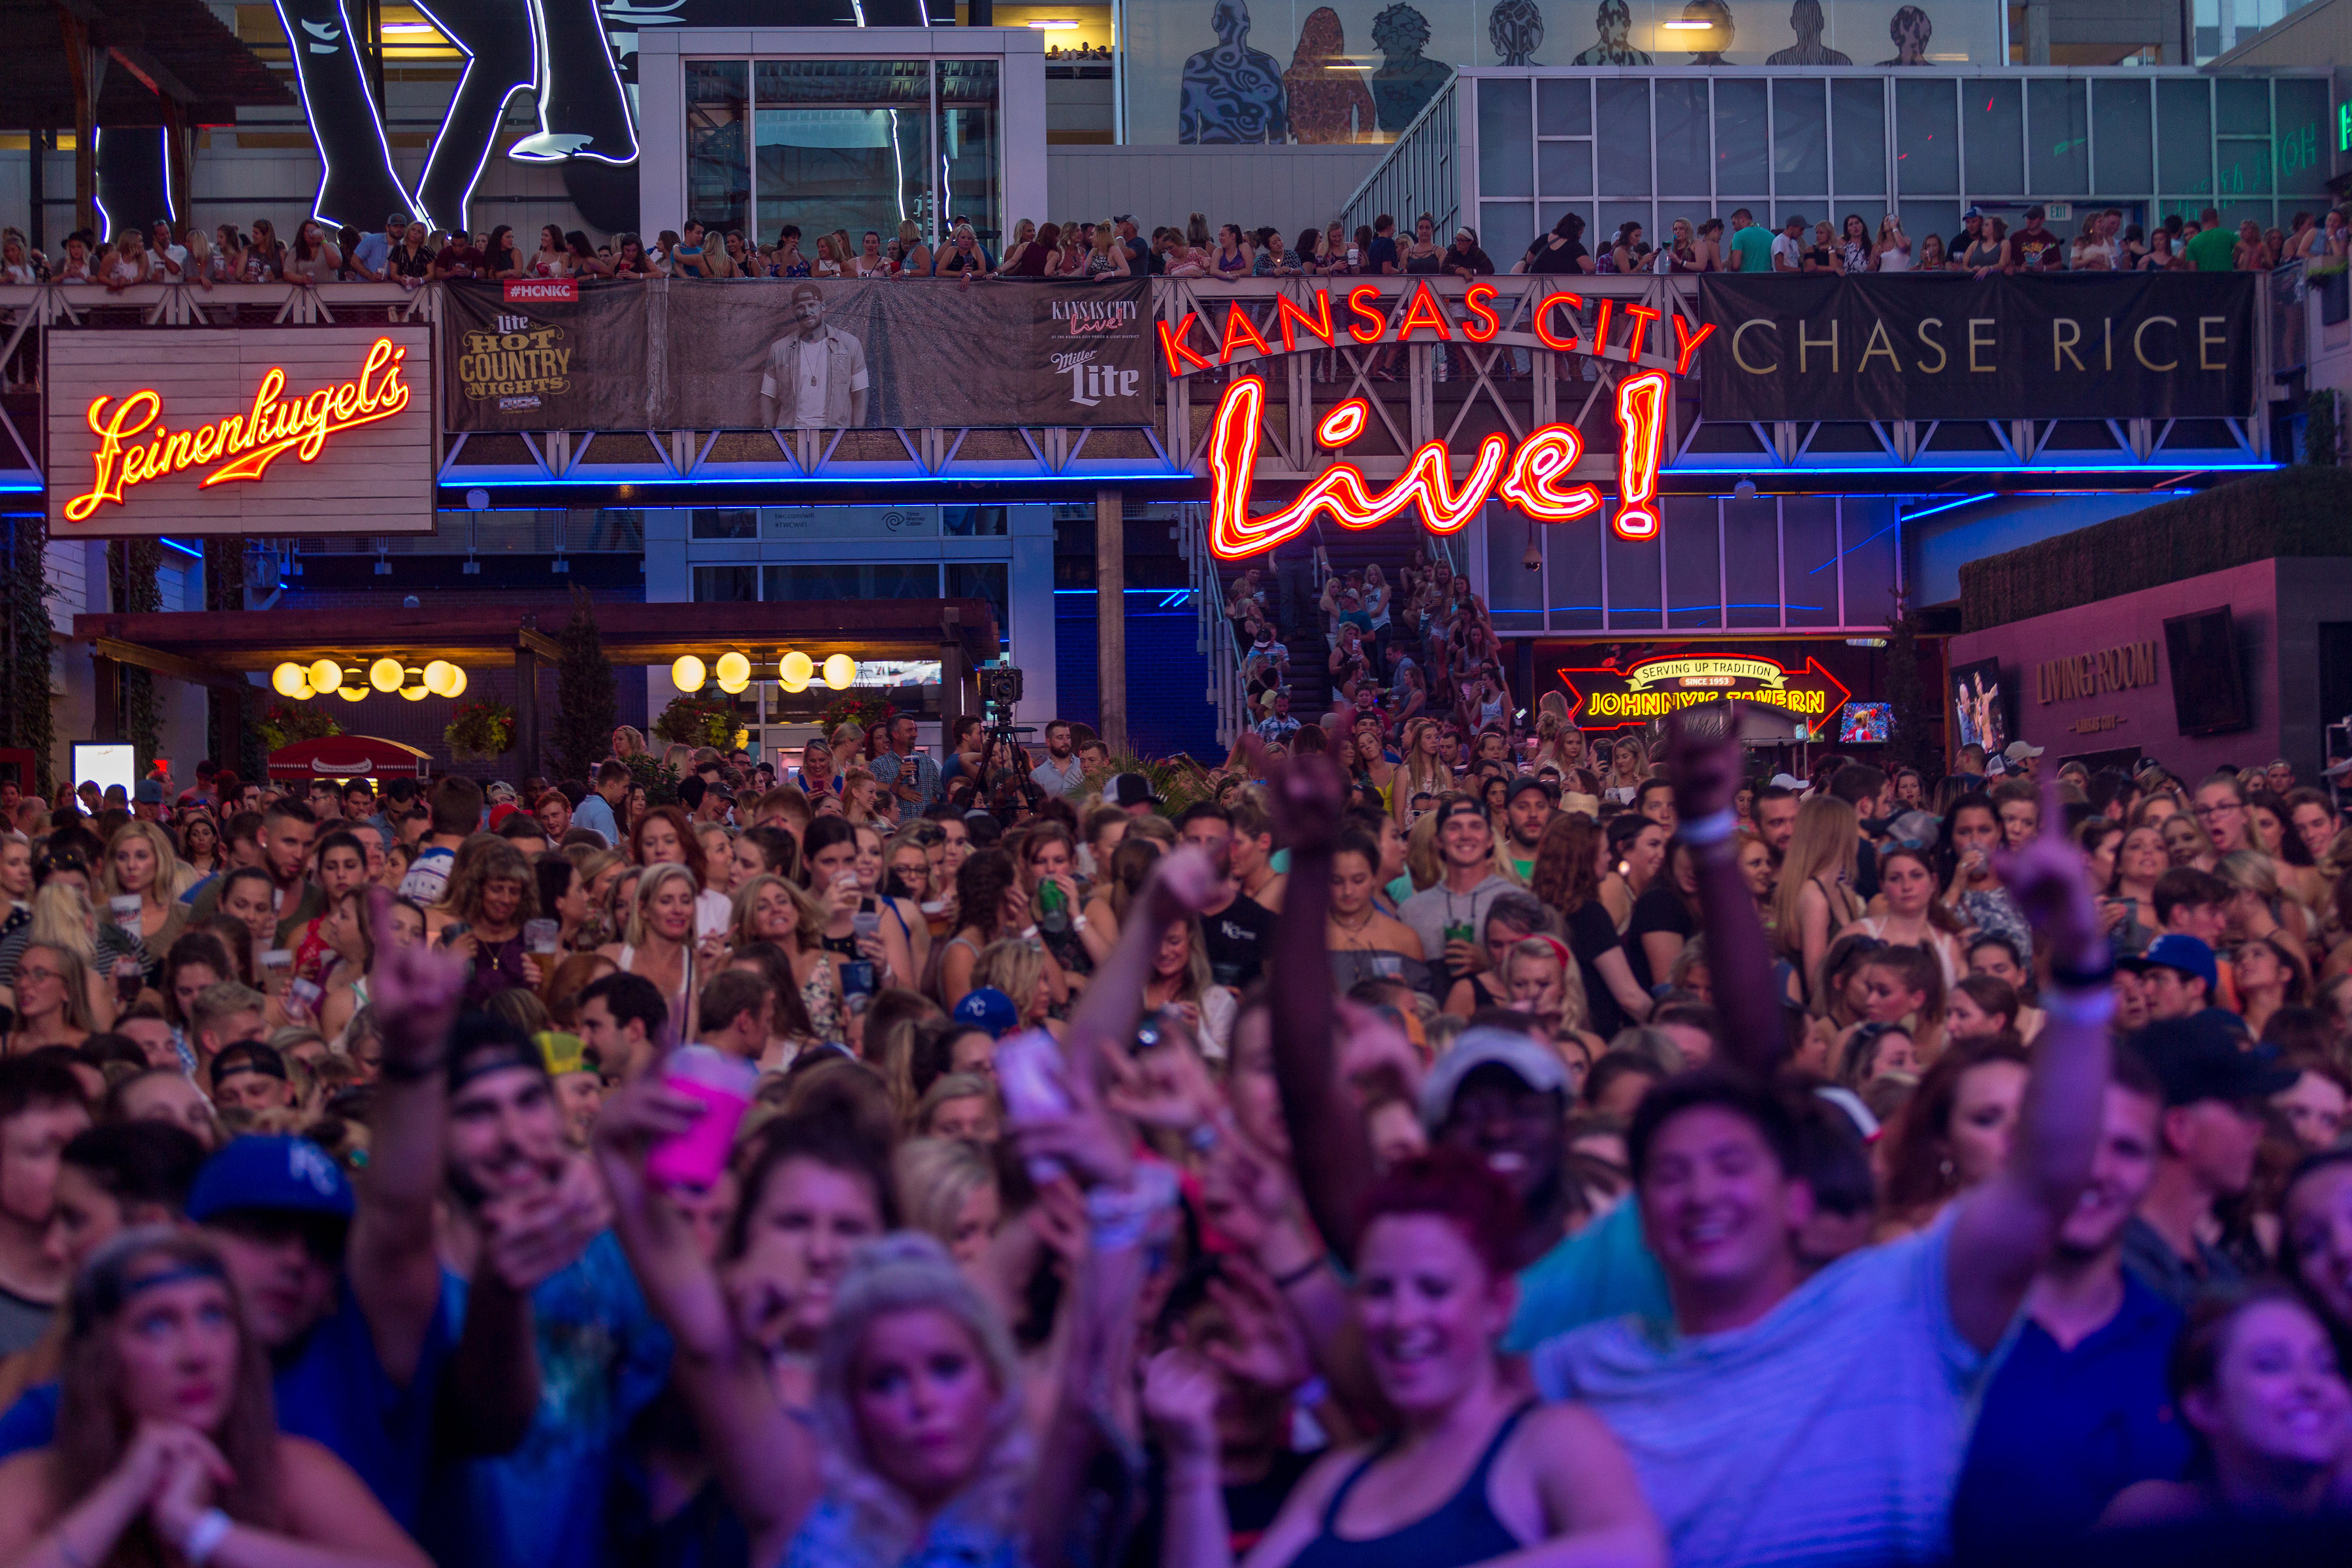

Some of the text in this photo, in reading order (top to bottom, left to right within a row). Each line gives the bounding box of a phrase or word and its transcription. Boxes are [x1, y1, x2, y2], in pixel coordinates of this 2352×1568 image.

[2050, 204, 2066, 218] EXIT
[510, 285, 570, 297] #HCNKC
[1052, 301, 1139, 319] KANSAS CITY
[1071, 308, 1123, 335] Live!
[497, 316, 529, 335] Lite
[1156, 281, 1717, 378] KANSAS CITY
[468, 329, 555, 353] HOT
[1732, 315, 2228, 375] CHASE RICE
[459, 348, 572, 382] COUNTRY
[1051, 350, 1098, 371] Miller
[470, 377, 564, 396] NIGHTS
[1054, 363, 1139, 406] Lite
[63, 336, 410, 523] Leinenkugel's
[1207, 368, 1673, 561] Live!
[1642, 662, 1772, 679] SERVING UP TRADITION
[1685, 677, 1730, 686] SINCE 1953
[2036, 640, 2157, 705] LIVING ROOM
